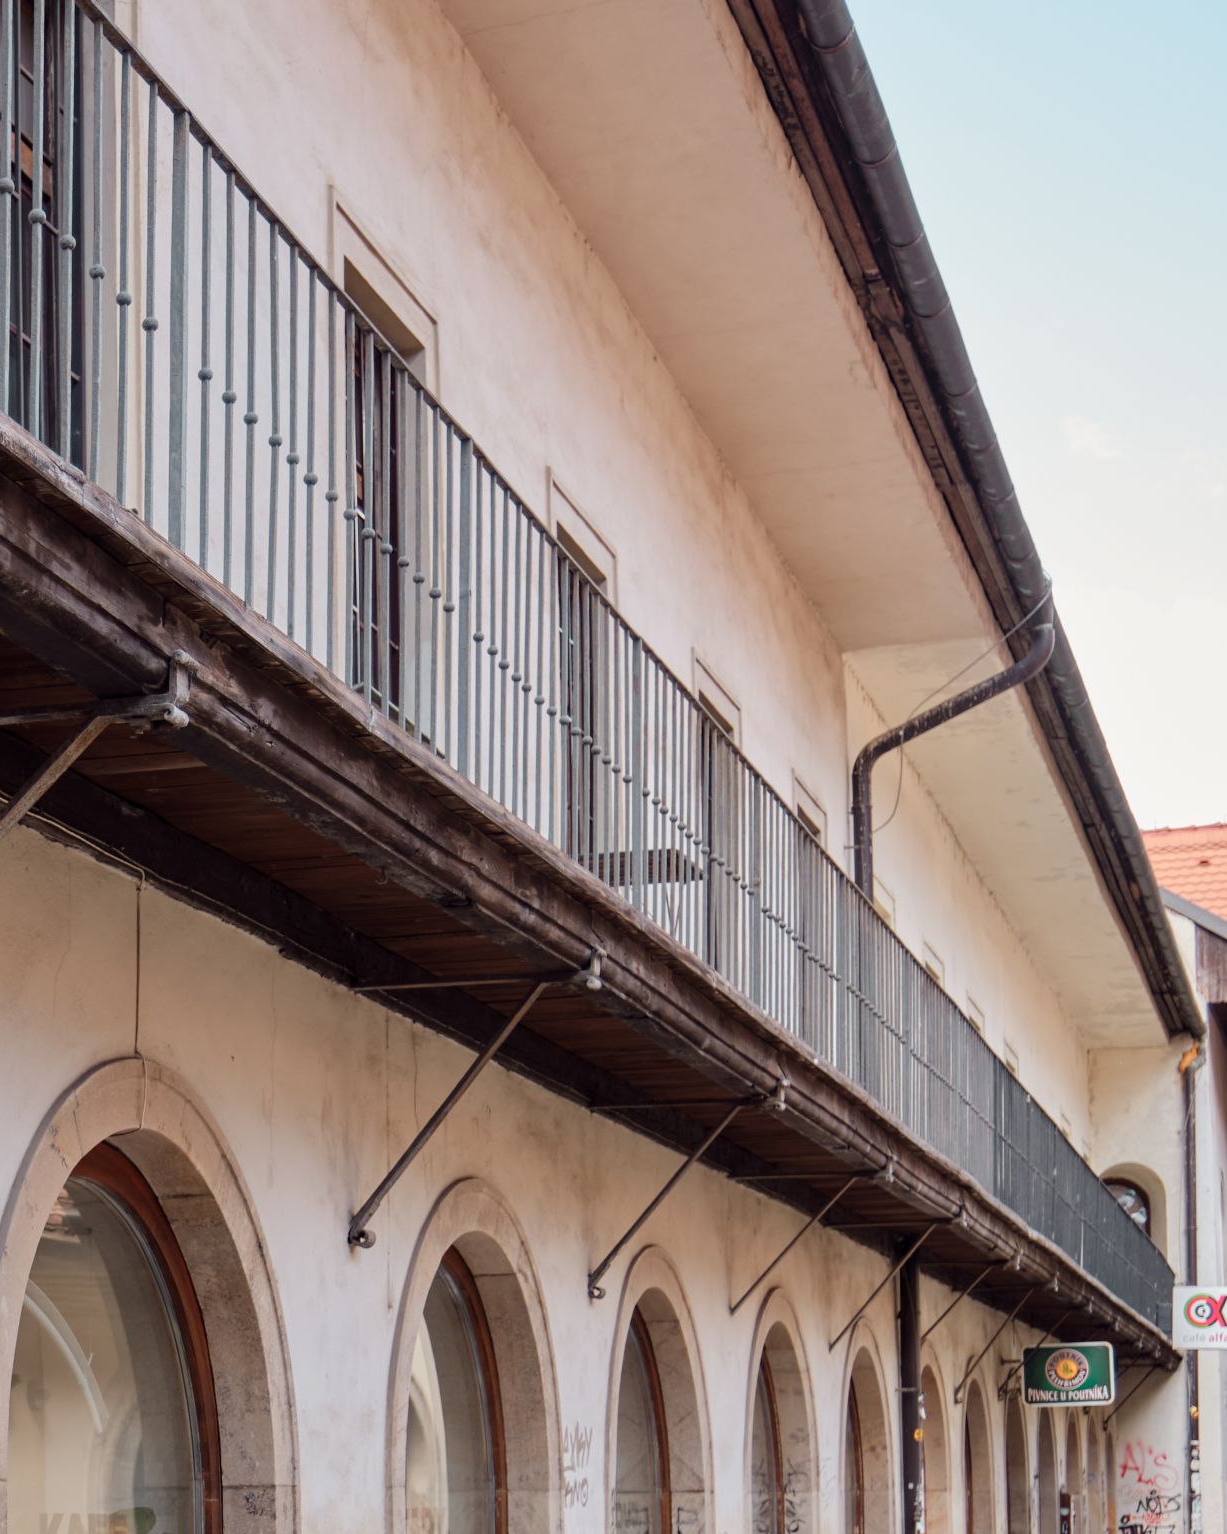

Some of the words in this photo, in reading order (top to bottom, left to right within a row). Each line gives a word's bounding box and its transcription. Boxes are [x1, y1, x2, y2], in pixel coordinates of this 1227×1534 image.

[1027, 1387, 1059, 1402] PIVNICE
[1059, 1390, 1066, 1401] U
[1067, 1384, 1109, 1401] POUTNÍKA
